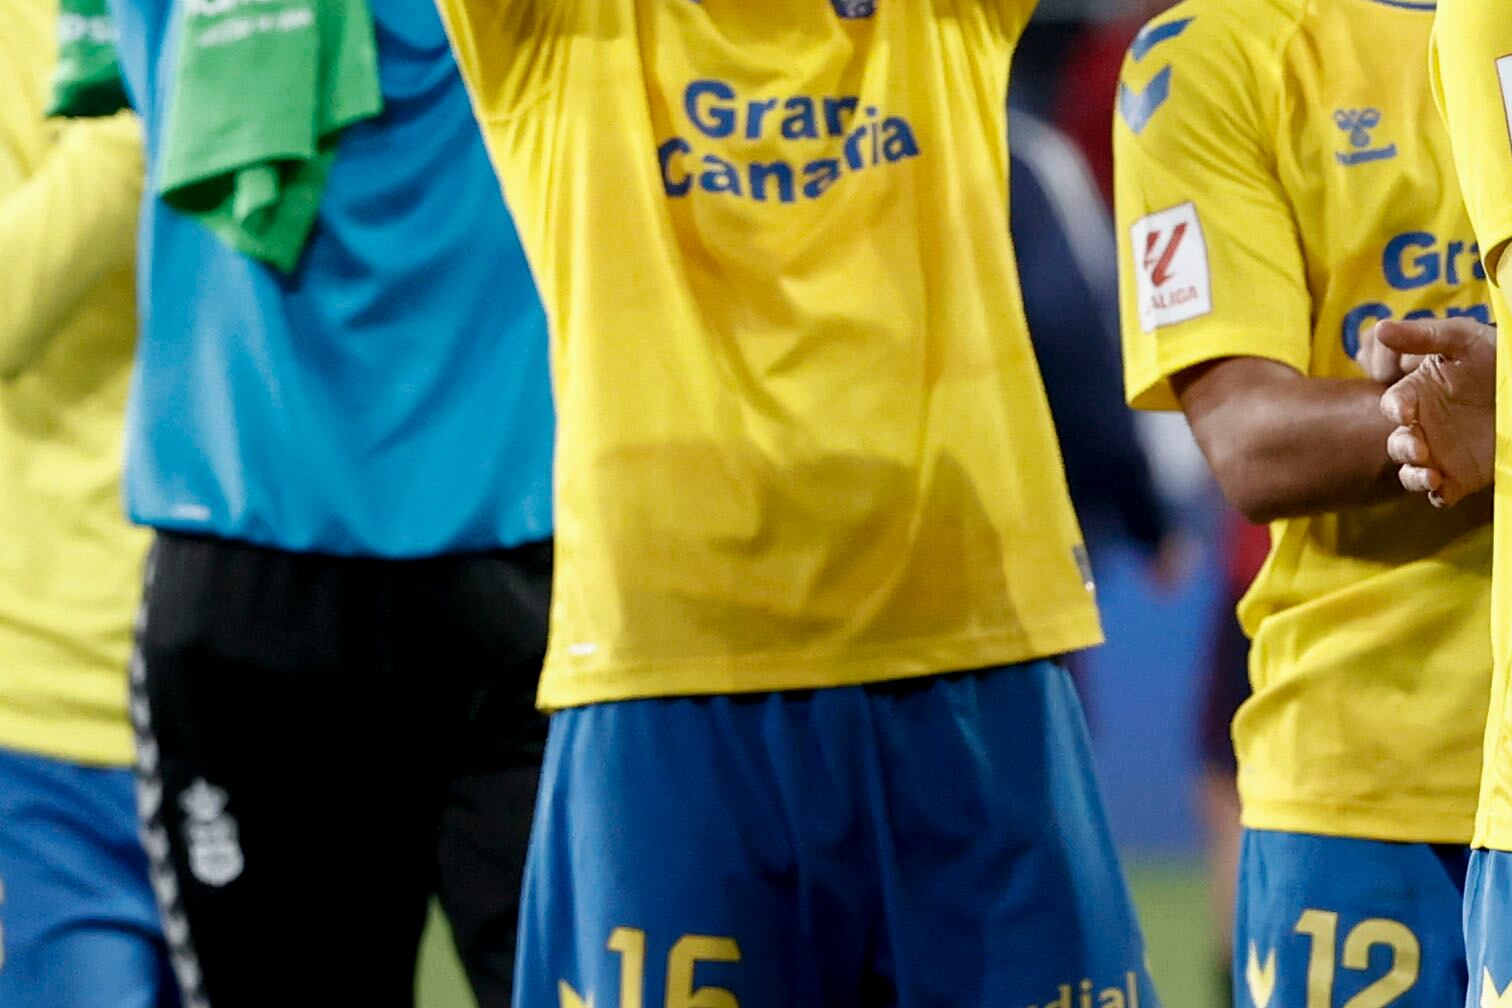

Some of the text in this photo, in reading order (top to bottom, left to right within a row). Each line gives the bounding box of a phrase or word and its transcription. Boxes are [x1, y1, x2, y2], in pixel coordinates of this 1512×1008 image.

[683, 79, 859, 139] Gran
[658, 105, 921, 203] Canaria
[1146, 285, 1199, 313] ALIGA
[607, 925, 742, 1008] 16
[1295, 908, 1421, 1008] 12
